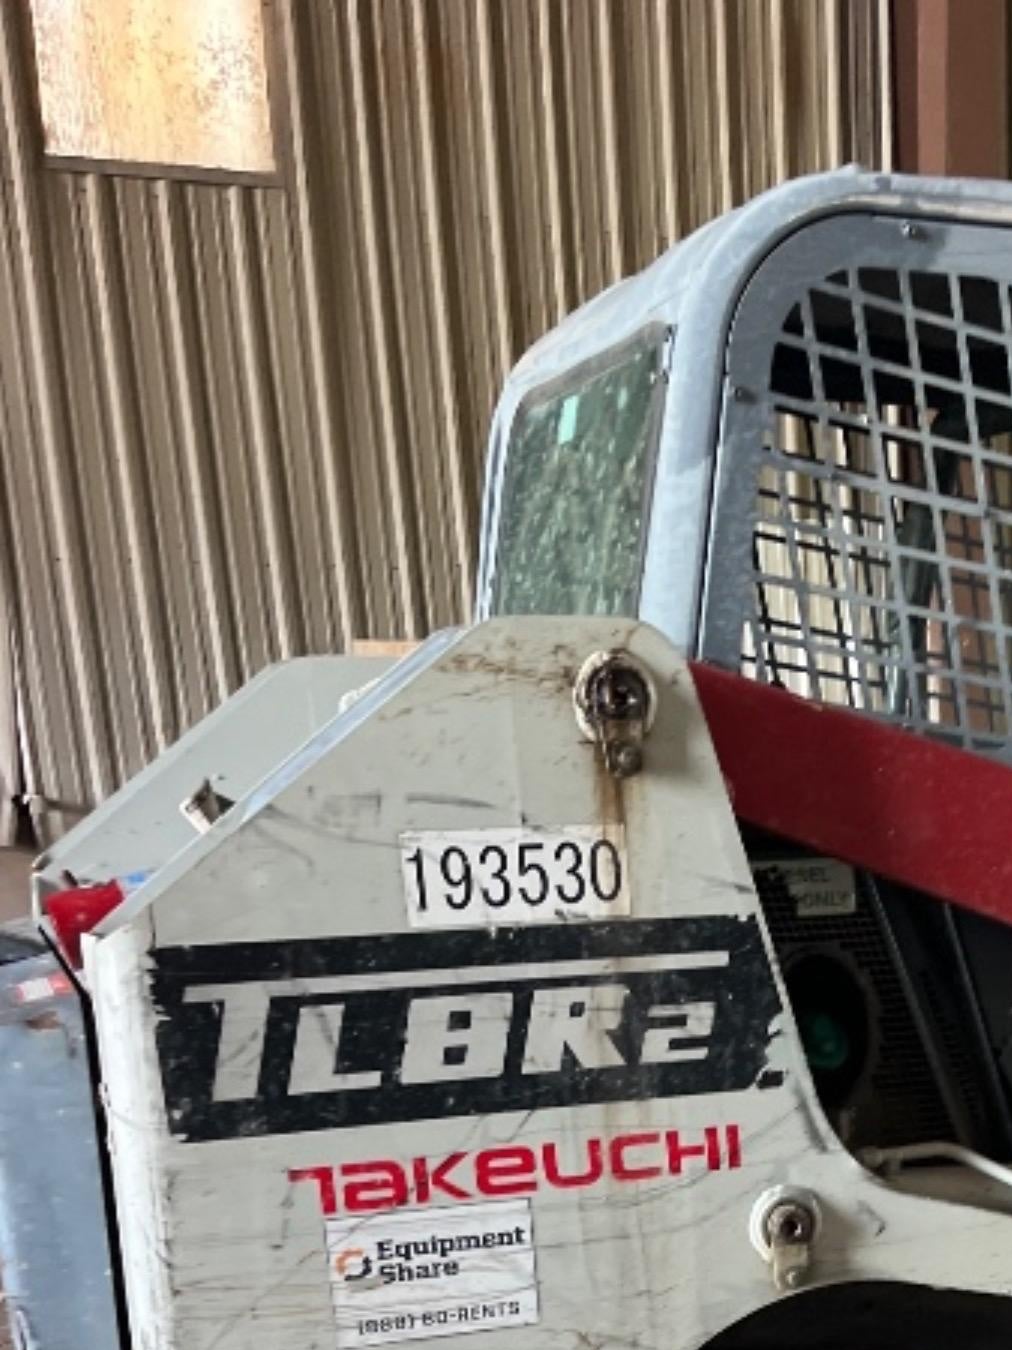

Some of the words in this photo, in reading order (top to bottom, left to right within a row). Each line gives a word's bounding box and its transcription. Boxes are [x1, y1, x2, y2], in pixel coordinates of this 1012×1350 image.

[405, 839, 622, 911] 193530
[376, 1226, 526, 1260] Equipment
[378, 1260, 460, 1285] Share
